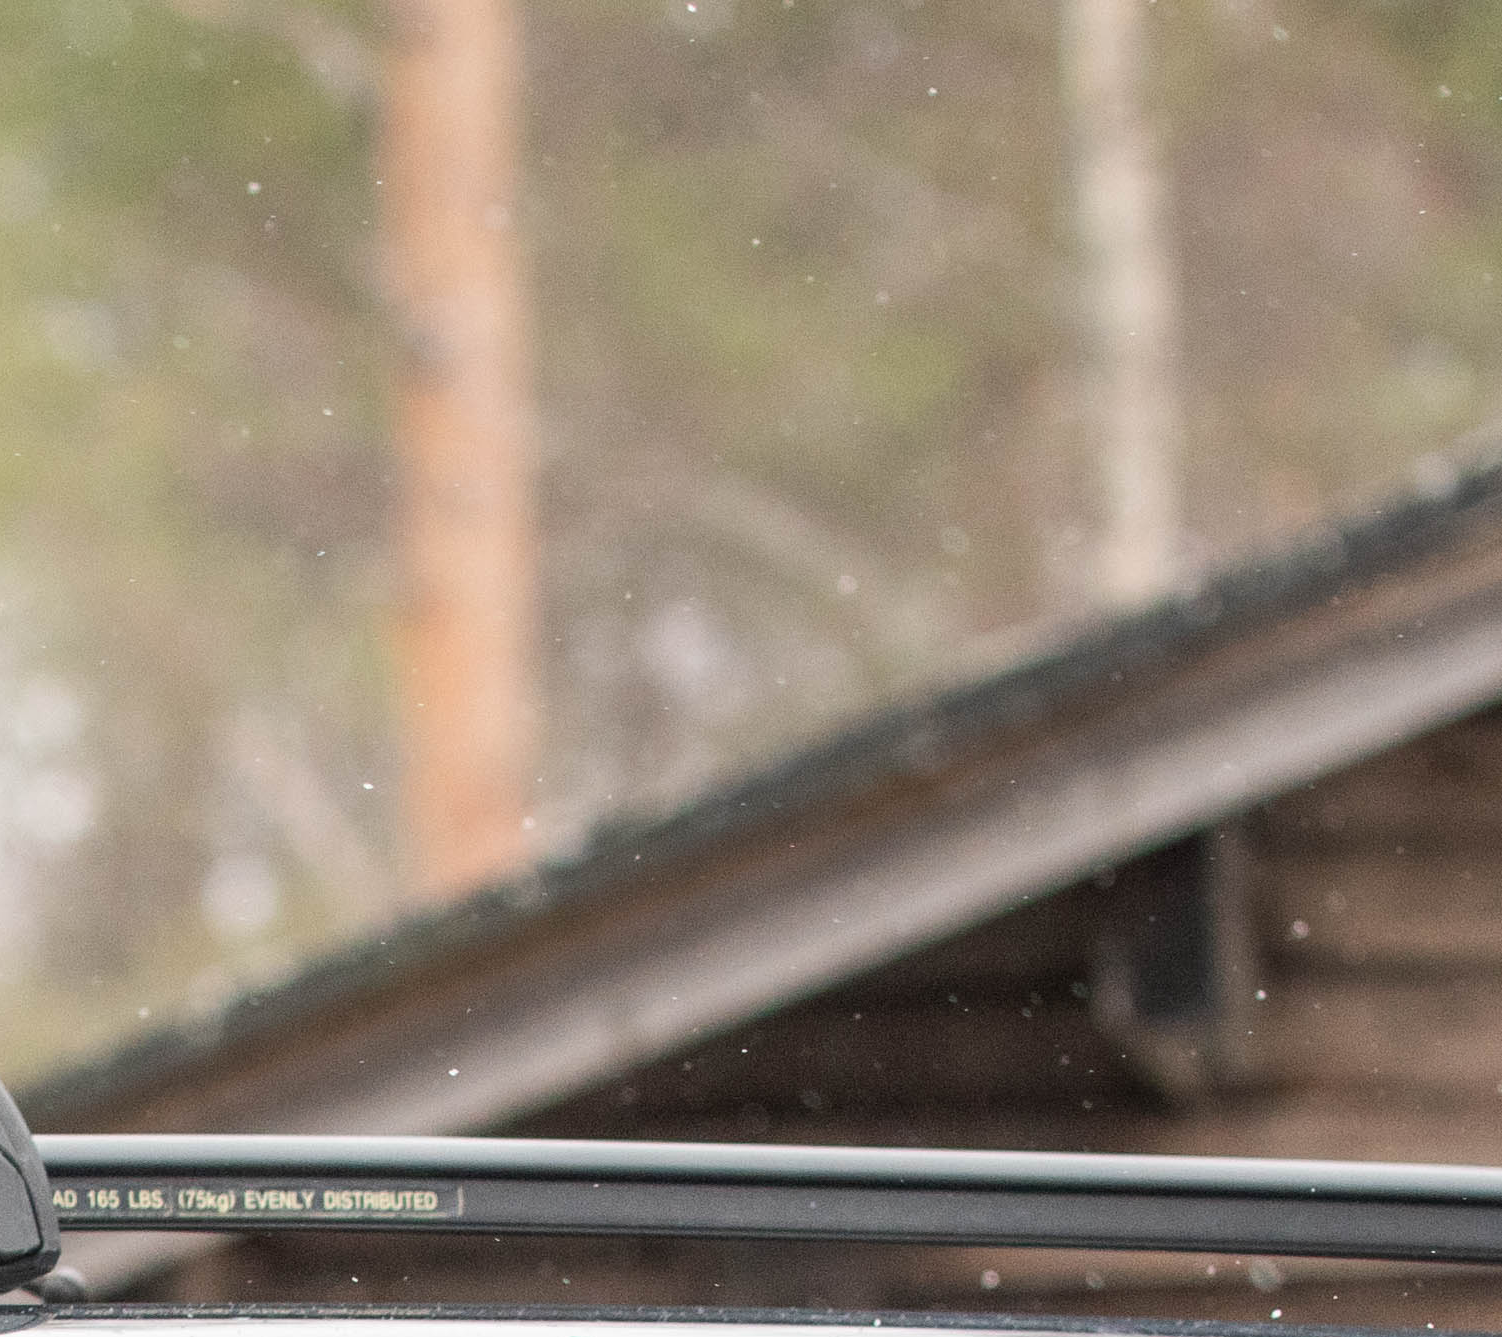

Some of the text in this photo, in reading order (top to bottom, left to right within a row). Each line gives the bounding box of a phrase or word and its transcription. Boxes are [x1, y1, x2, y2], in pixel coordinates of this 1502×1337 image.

[87, 1189, 120, 1209] 165
[178, 1188, 236, 1213] (75kg)
[243, 1188, 315, 1210] EVENLY
[322, 1189, 438, 1211] DISTRIBUTED
